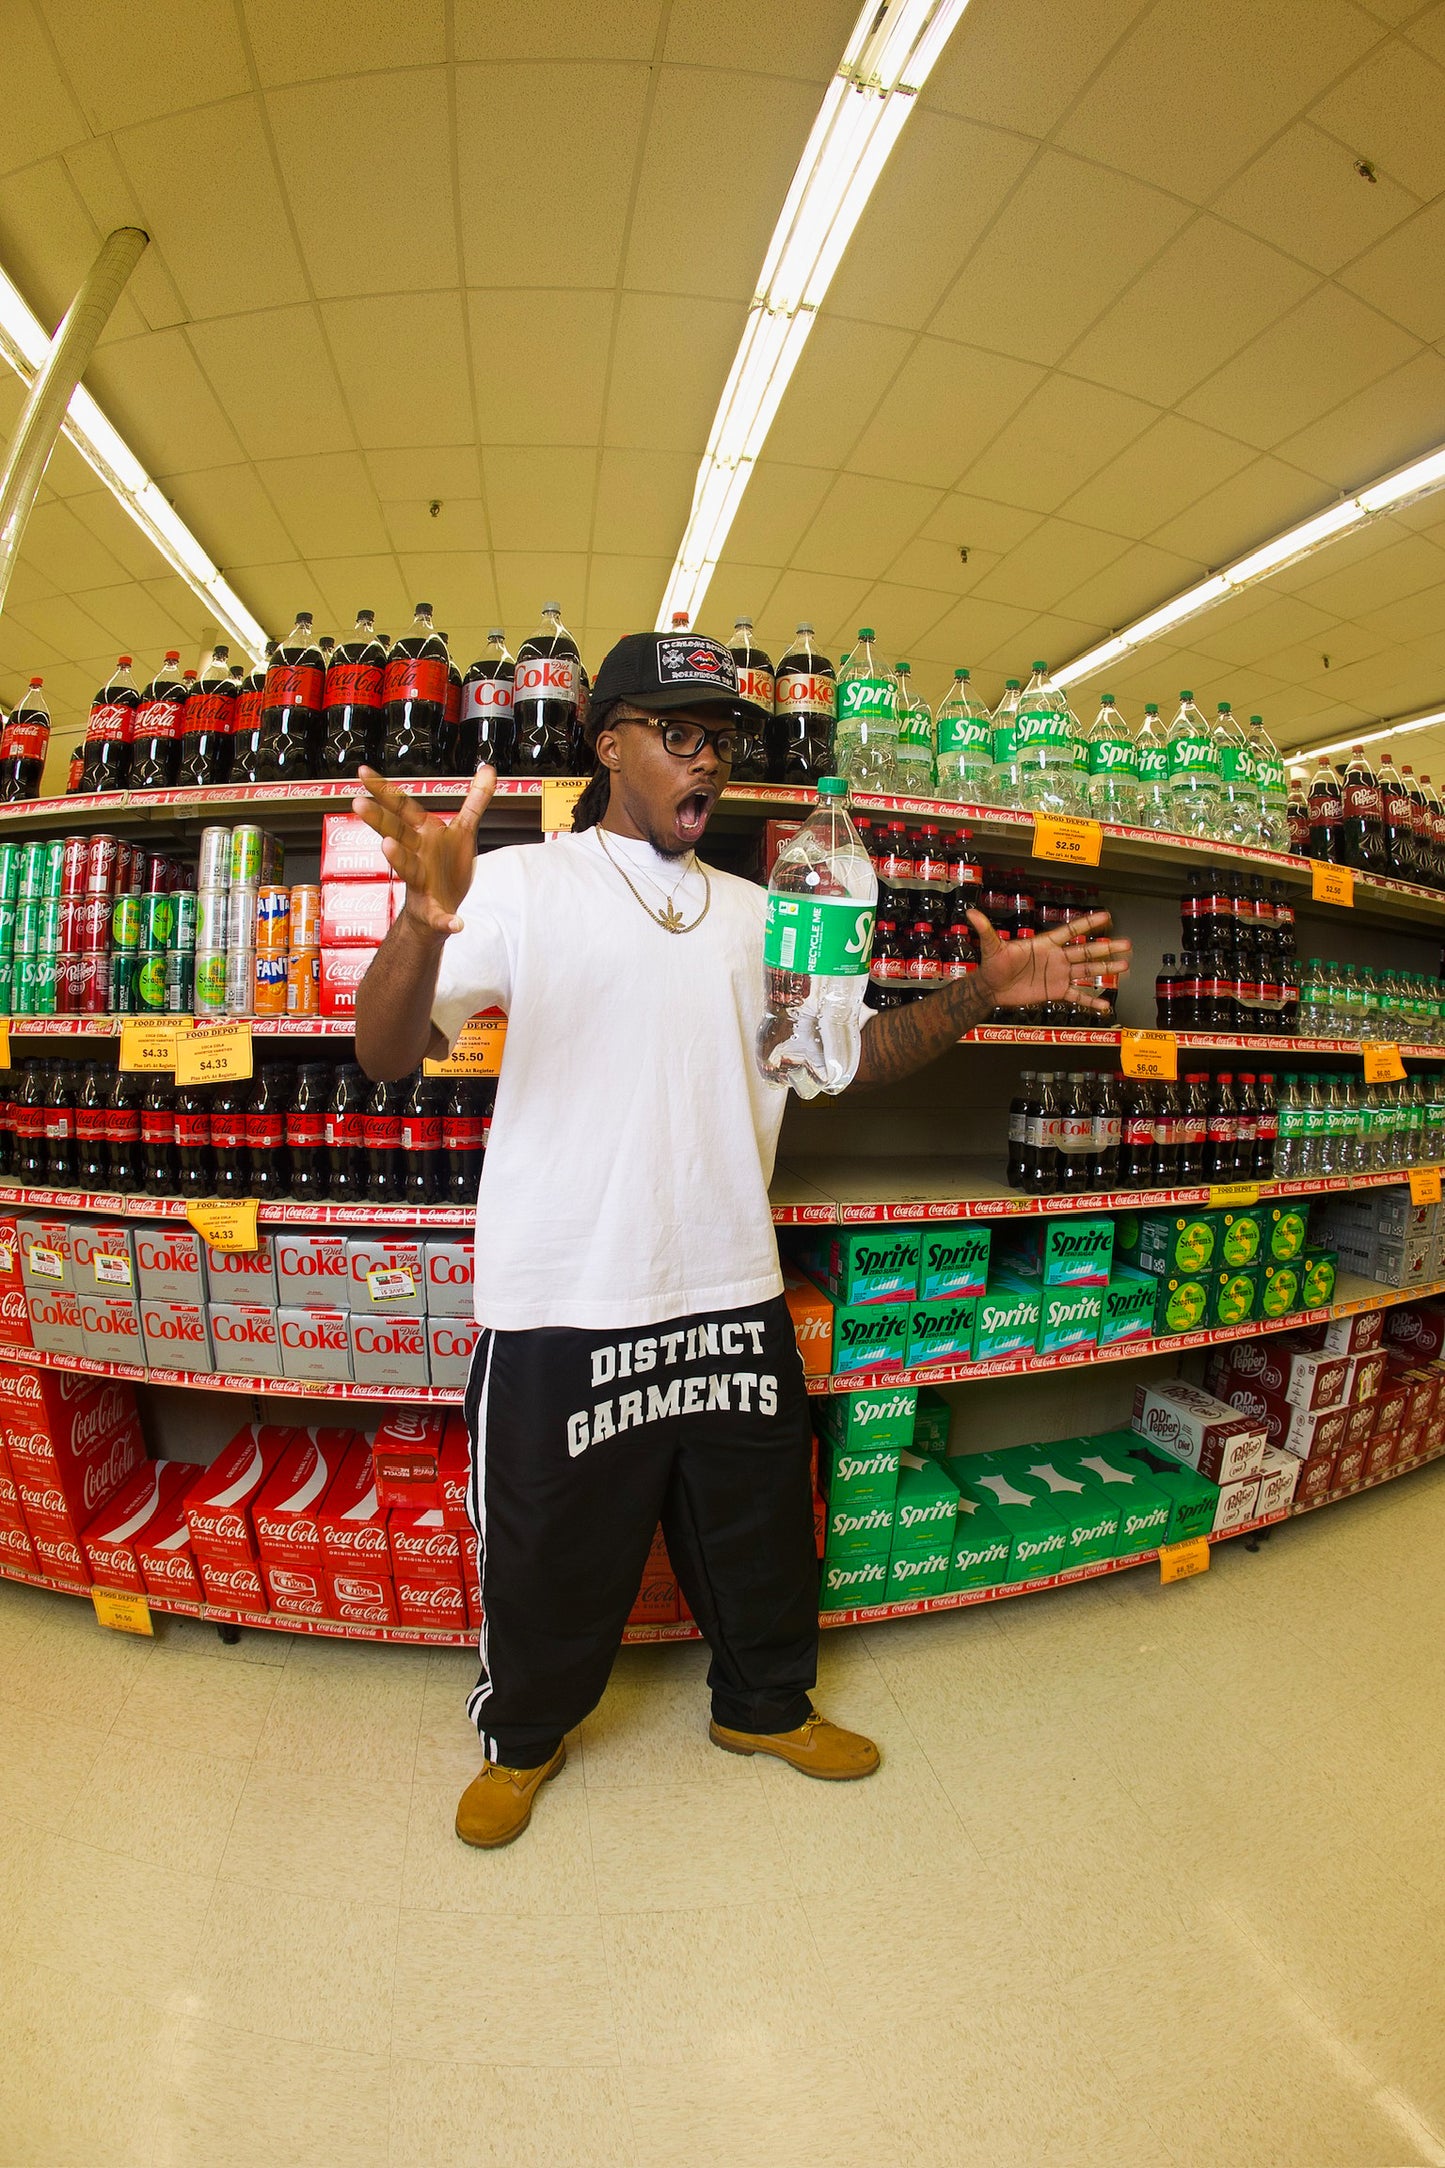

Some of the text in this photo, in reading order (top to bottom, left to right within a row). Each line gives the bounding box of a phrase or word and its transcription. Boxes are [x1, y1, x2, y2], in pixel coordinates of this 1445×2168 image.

[514, 663, 573, 692] Coke
[776, 678, 835, 706] Coke
[253, 786, 325, 798] Coca-Cola Coca-Cola
[432, 782, 469, 794] Coca-Cola
[853, 796, 970, 818] Coca-Cola Coca-Cola Coca-Cola
[1056, 841, 1081, 851] $2.50
[336, 854, 375, 869] mini
[1326, 885, 1341, 895] $2.50
[812, 907, 822, 922] ME
[335, 922, 373, 937] mini
[808, 925, 820, 971] RECYCLE
[20, 1020, 73, 1032] Coca-Cola Coca-Cola
[186, 1027, 239, 1039] FOOD DEPOT
[281, 1021, 314, 1032] Coca-Cola
[984, 1029, 1116, 1043] Coca-Cola Coca-Cola Coca-Cola Coca-Cola
[142, 1048, 169, 1058] $4.33
[200, 1058, 228, 1071] $4.33
[451, 1052, 484, 1062] $5.50
[1137, 1063, 1158, 1073] $6.00
[129, 1199, 156, 1211] Coca-Cola
[844, 1203, 959, 1219] Coca-Cola Coca-Cola Coca-Cola
[52, 1232, 67, 1242] Diet
[107, 1239, 124, 1248] Diet
[209, 1230, 234, 1240] $4.33
[1052, 1230, 1112, 1257] Sprite
[1180, 1235, 1212, 1249] Seagram's
[1228, 1231, 1258, 1244] Seagram's
[138, 1243, 199, 1273] Coke
[176, 1242, 194, 1252] Diet
[323, 1247, 343, 1256] Diet
[397, 1253, 418, 1263] Diet
[928, 1240, 989, 1271] Sprite
[280, 1248, 348, 1276] Coke
[855, 1243, 919, 1275] Sprite
[61, 1299, 76, 1308] Diet
[1106, 1288, 1155, 1318] Sprite
[1171, 1294, 1204, 1308] Seagram's
[1222, 1288, 1253, 1301] Seagram's
[29, 1298, 82, 1327] Coke
[81, 1306, 139, 1336] Coke
[116, 1308, 133, 1318] Diet
[181, 1313, 200, 1323] Diet
[253, 1316, 272, 1325] Diet
[912, 1308, 974, 1339] Sprite
[981, 1302, 1039, 1333] Sprite
[1047, 1297, 1101, 1328] Sprite
[145, 1312, 205, 1342] Coke
[212, 1315, 275, 1343] Coke
[281, 1322, 348, 1350] Coke
[323, 1321, 343, 1331] Diet
[399, 1326, 420, 1336] Diet
[841, 1315, 906, 1345] Sprite
[354, 1327, 424, 1355] Coke
[53, 1354, 105, 1371] Coca-Cola Coca-Cola
[590, 1321, 766, 1388] DISTINCT
[834, 1369, 945, 1388] Coca-Cola Coca-Cola Coca-Cola
[566, 1372, 779, 1459] GARMENTS
[853, 1396, 915, 1426] Sprite
[1148, 1409, 1178, 1434] Pepper
[1158, 1410, 1172, 1424] Dr
[5, 1429, 54, 1457] Coca-Cola
[1178, 1439, 1191, 1451] Diet
[837, 1453, 898, 1481] Sprite
[19, 1484, 68, 1513] Coca-Cola
[899, 1500, 957, 1528] Sprite
[1124, 1508, 1169, 1535] Sprite
[1176, 1498, 1216, 1523] Sprite
[188, 1510, 247, 1539] Coca-Cola
[257, 1517, 320, 1543] Coca-Cola
[832, 1510, 892, 1536] Sprite
[1070, 1519, 1118, 1547] Sprite
[34, 1535, 82, 1564] Coca-Cola
[194, 1535, 222, 1544] ORIGINAL
[264, 1541, 294, 1549] ORIGINAL
[322, 1525, 388, 1551] Coca-Cola
[393, 1531, 460, 1556] Coca-Cola
[1016, 1534, 1066, 1562] Sprite
[86, 1544, 137, 1572] Coca-Cola
[329, 1550, 359, 1558] ORIGINAL
[399, 1556, 430, 1564] ORIGINAL
[955, 1543, 1009, 1571] Sprite
[140, 1553, 195, 1580] Coca-Cola
[203, 1564, 261, 1591] Coca-Cola
[827, 1564, 886, 1590] Sprite
[892, 1555, 949, 1581] Sprite
[276, 1596, 323, 1614] Coca-Cola
[400, 1584, 463, 1608] Coca-Cola
[340, 1604, 389, 1622] Coca-Cola
